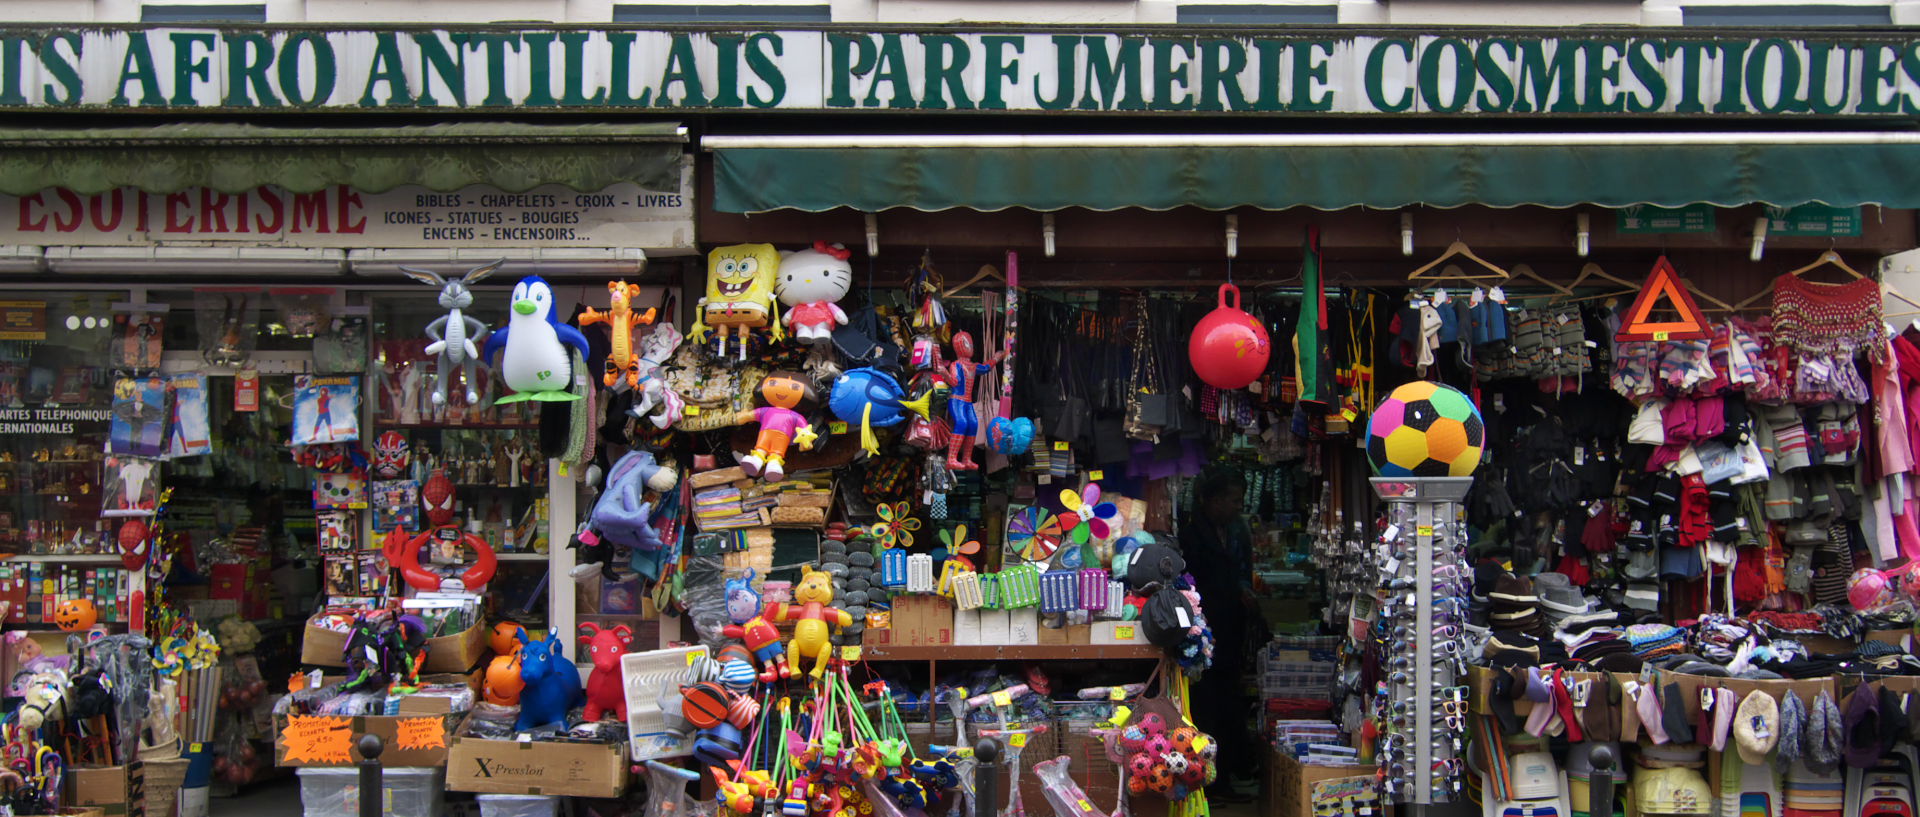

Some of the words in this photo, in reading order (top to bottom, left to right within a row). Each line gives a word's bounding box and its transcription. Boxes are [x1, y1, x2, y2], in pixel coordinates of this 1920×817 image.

[110, 31, 336, 107] AFRO
[361, 32, 786, 108] ANTILLAIS
[416, 194, 461, 208] BIBLES
[480, 194, 556, 208] CHAPELETS
[575, 194, 615, 208] CROIX
[637, 194, 682, 208] LIVRES
[384, 211, 431, 224] ICONES
[448, 211, 502, 224] STATUES
[522, 210, 579, 224] BOUGIES
[423, 227, 474, 240] ENCENS
[474, 757, 545, 778] X-Pression
